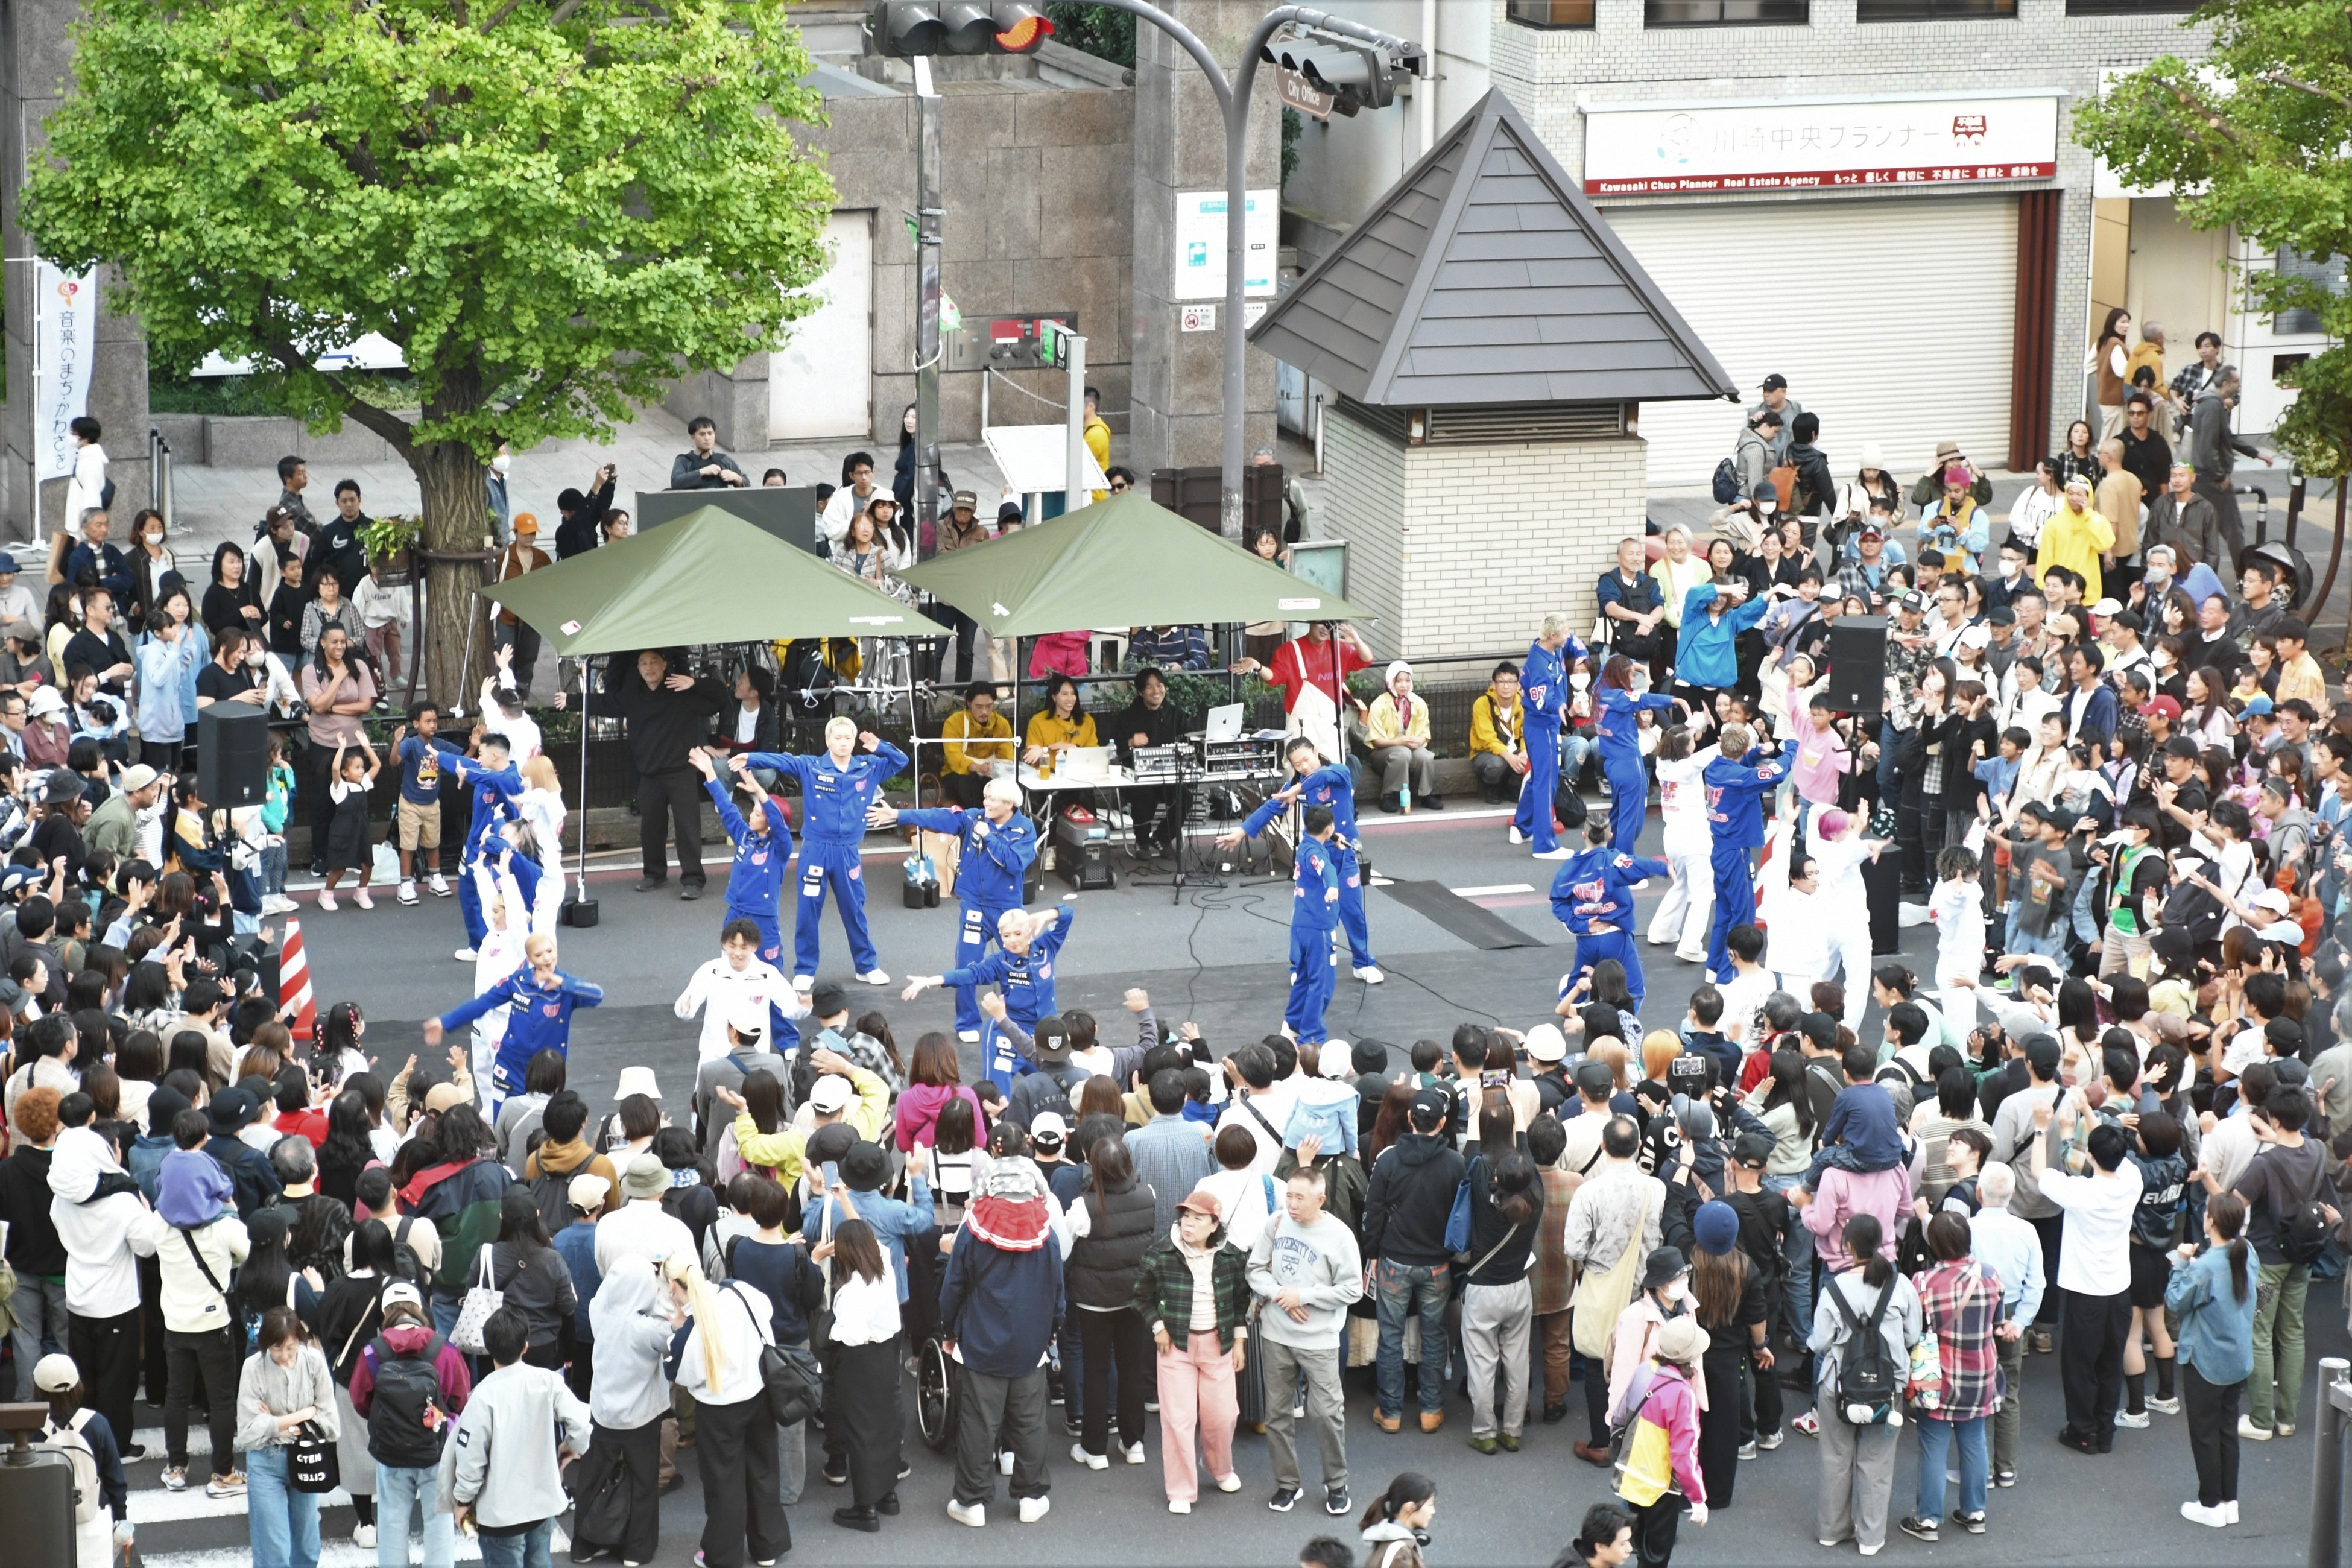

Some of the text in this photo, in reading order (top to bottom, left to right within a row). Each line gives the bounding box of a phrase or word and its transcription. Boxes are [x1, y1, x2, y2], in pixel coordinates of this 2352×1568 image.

[1288, 80, 1320, 106] City Office
[1600, 176, 1820, 192] Kawasaki Chuo Planner Real Estate Agency
[1834, 173, 1857, 184] もっと
[1932, 169, 1970, 180] 不動産に
[1530, 686, 1546, 701] 87
[1308, 1250, 1317, 1266] OF
[297, 1472, 326, 1482] CITEN
